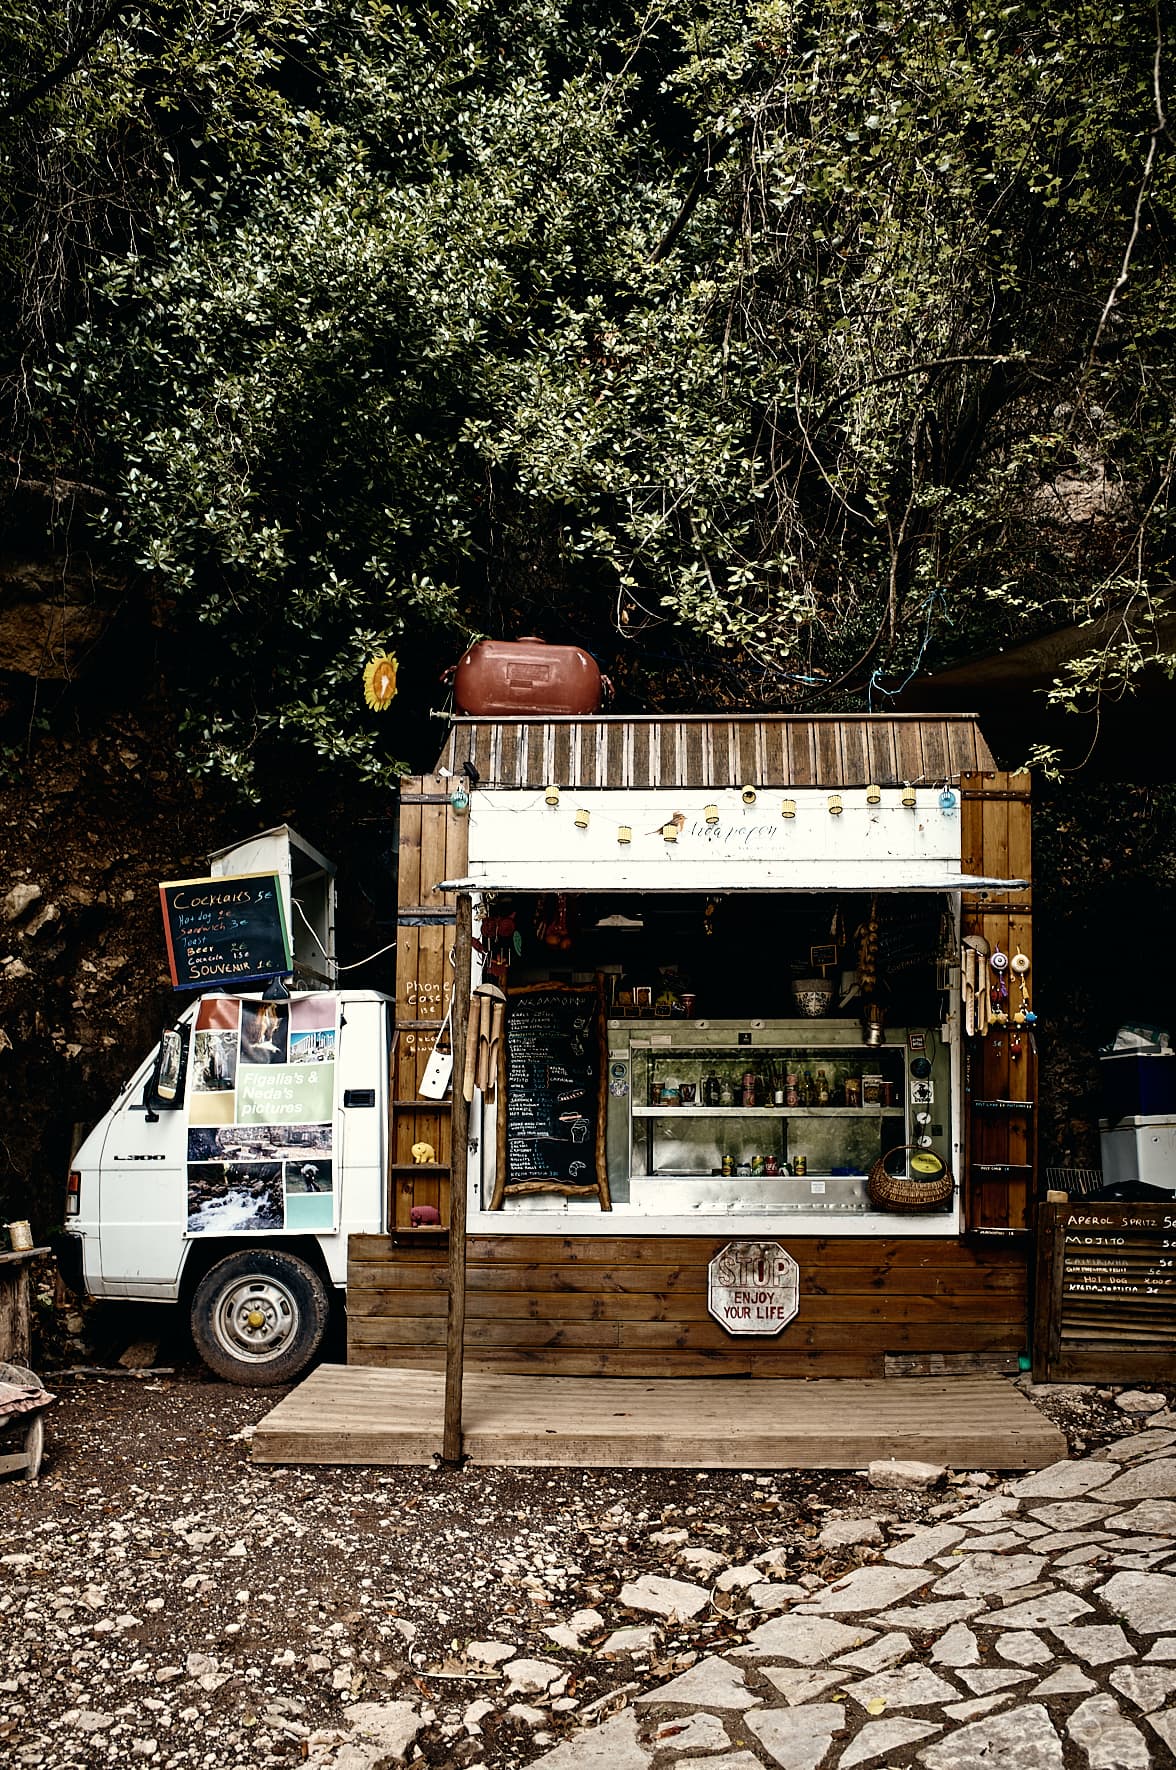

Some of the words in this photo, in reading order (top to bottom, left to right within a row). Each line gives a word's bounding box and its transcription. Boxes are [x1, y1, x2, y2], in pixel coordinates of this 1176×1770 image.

[188, 961, 251, 979] SOUVENIR
[307, 1071, 319, 1083] &
[242, 1087, 294, 1100] Neda's
[241, 1102, 303, 1117] pictures
[1067, 1215, 1114, 1225] APEROL
[1121, 1217, 1157, 1227] SPRITZ
[1065, 1236, 1125, 1245] MOJITO
[1083, 1276, 1101, 1284] HOT
[1109, 1276, 1128, 1284] DOG
[734, 1292, 775, 1304] ENJOY
[724, 1307, 751, 1319] YOUR
[757, 1307, 785, 1319] LIFE
